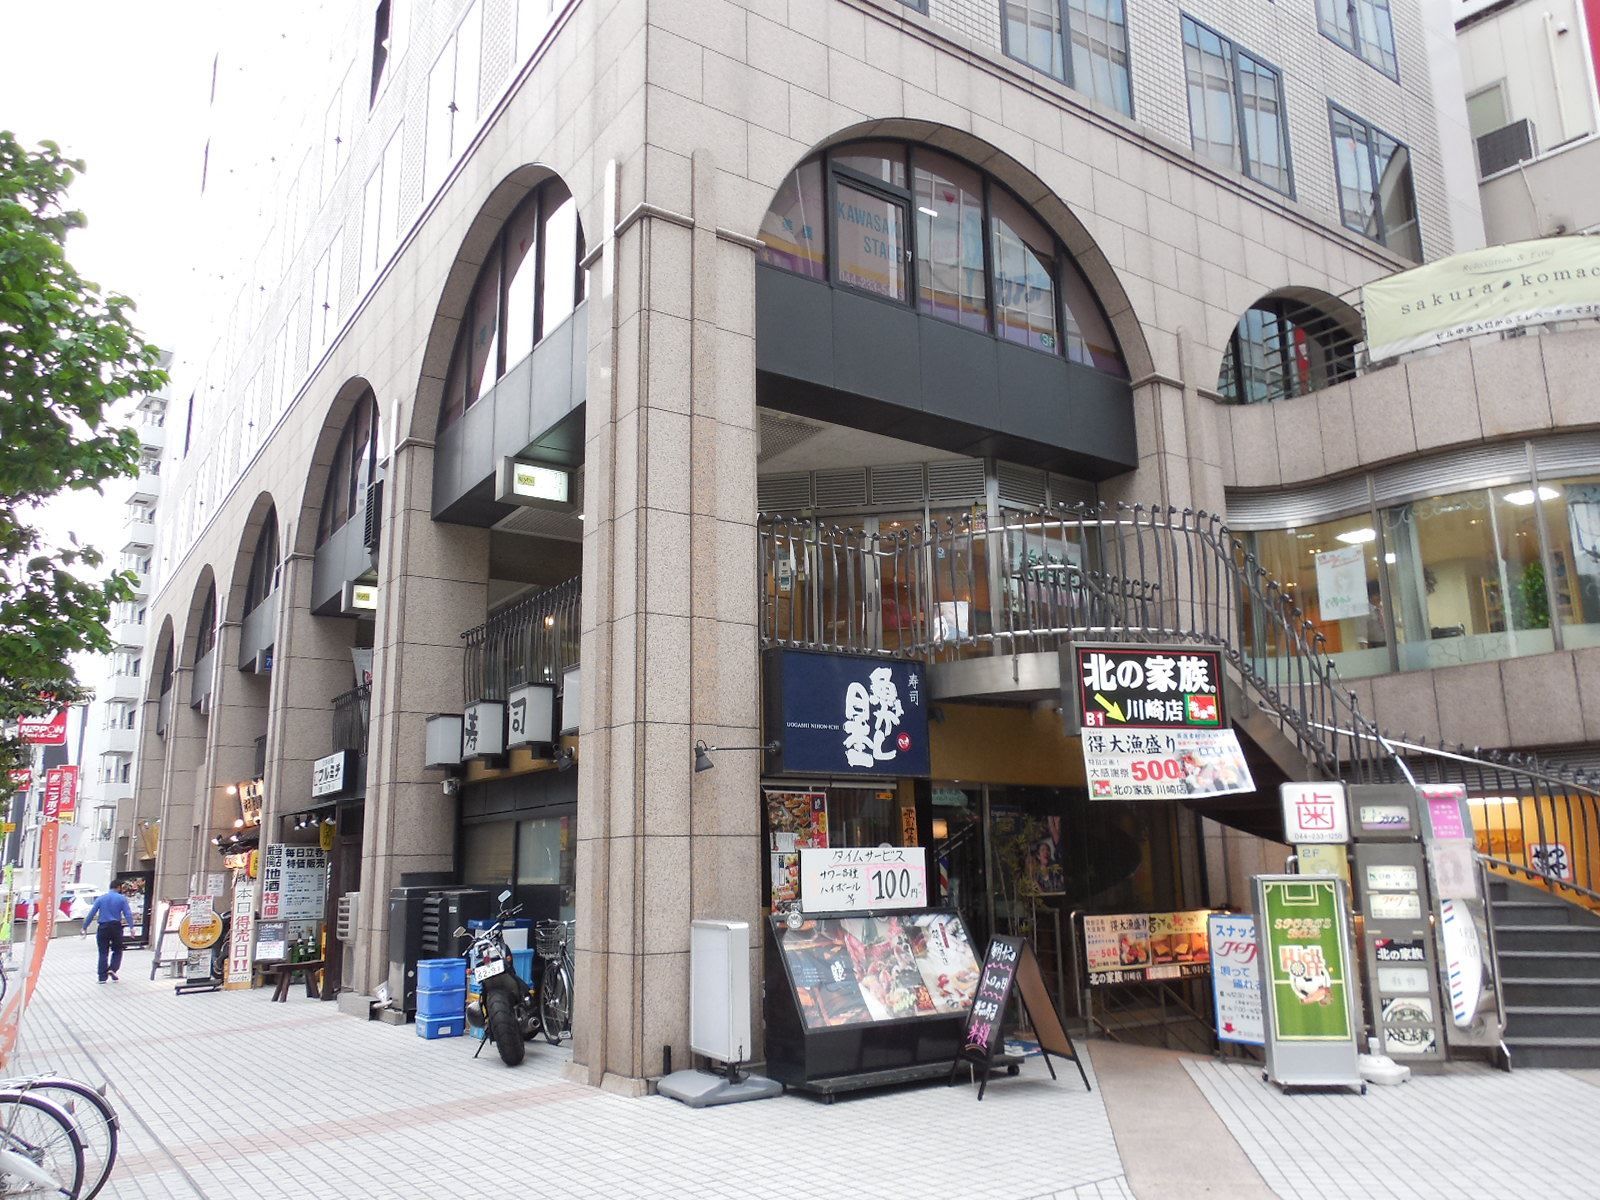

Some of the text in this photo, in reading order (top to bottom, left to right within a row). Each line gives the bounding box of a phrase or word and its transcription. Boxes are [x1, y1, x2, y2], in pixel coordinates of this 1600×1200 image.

[1401, 284, 1493, 316] sakura
[1083, 653, 1210, 693] 北の家族
[908, 672, 919, 707] 寿司
[1126, 699, 1184, 722] 川崎店
[1086, 711, 1105, 727] B1
[1087, 734, 1176, 755] 得大漁盛り
[1113, 784, 1187, 796] 北の家族 川崎店
[1295, 792, 1335, 831] 歯
[832, 849, 906, 864] タイムサービス
[1302, 848, 1320, 859] 2F
[286, 859, 325, 869] 特価販売
[820, 883, 861, 894] ハイボール
[1215, 924, 1256, 938] スナック
[1377, 947, 1424, 960] 北の家族
[1089, 972, 1124, 985] 北の家族
